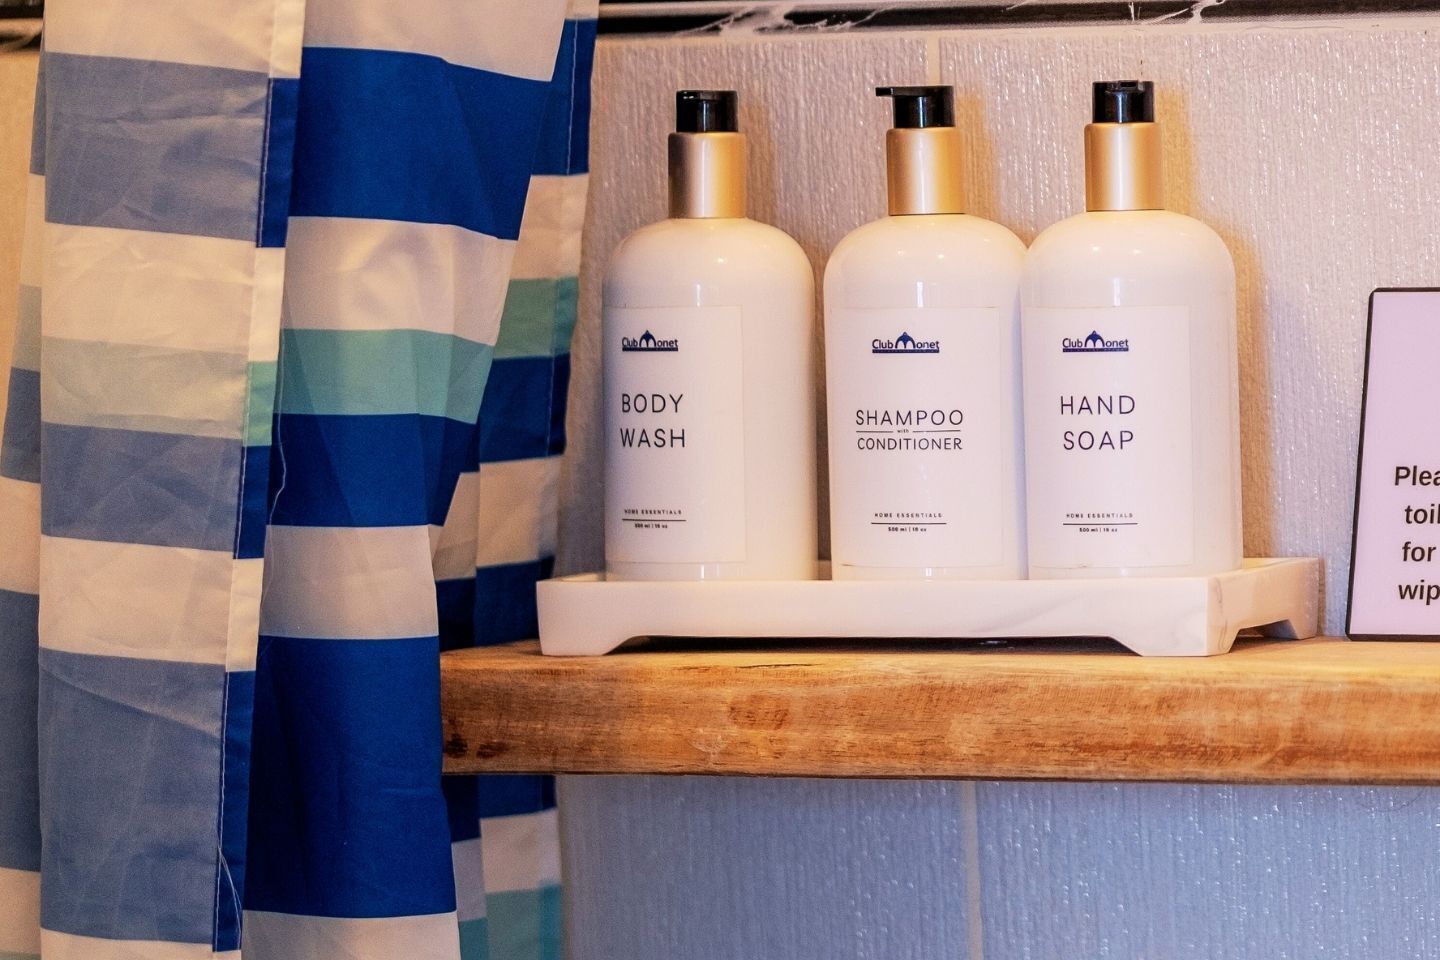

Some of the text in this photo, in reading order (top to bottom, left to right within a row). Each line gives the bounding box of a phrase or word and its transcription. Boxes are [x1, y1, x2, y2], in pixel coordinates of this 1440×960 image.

[871, 338, 894, 349] Club
[1062, 337, 1083, 348] Club
[621, 393, 684, 414] BODY
[1060, 395, 1136, 415] HAND
[855, 408, 964, 426] SHAMPOO
[619, 427, 686, 449] WASH
[857, 437, 964, 451] CONDITIONER
[1062, 430, 1135, 451] SOAP
[1402, 541, 1436, 562] for
